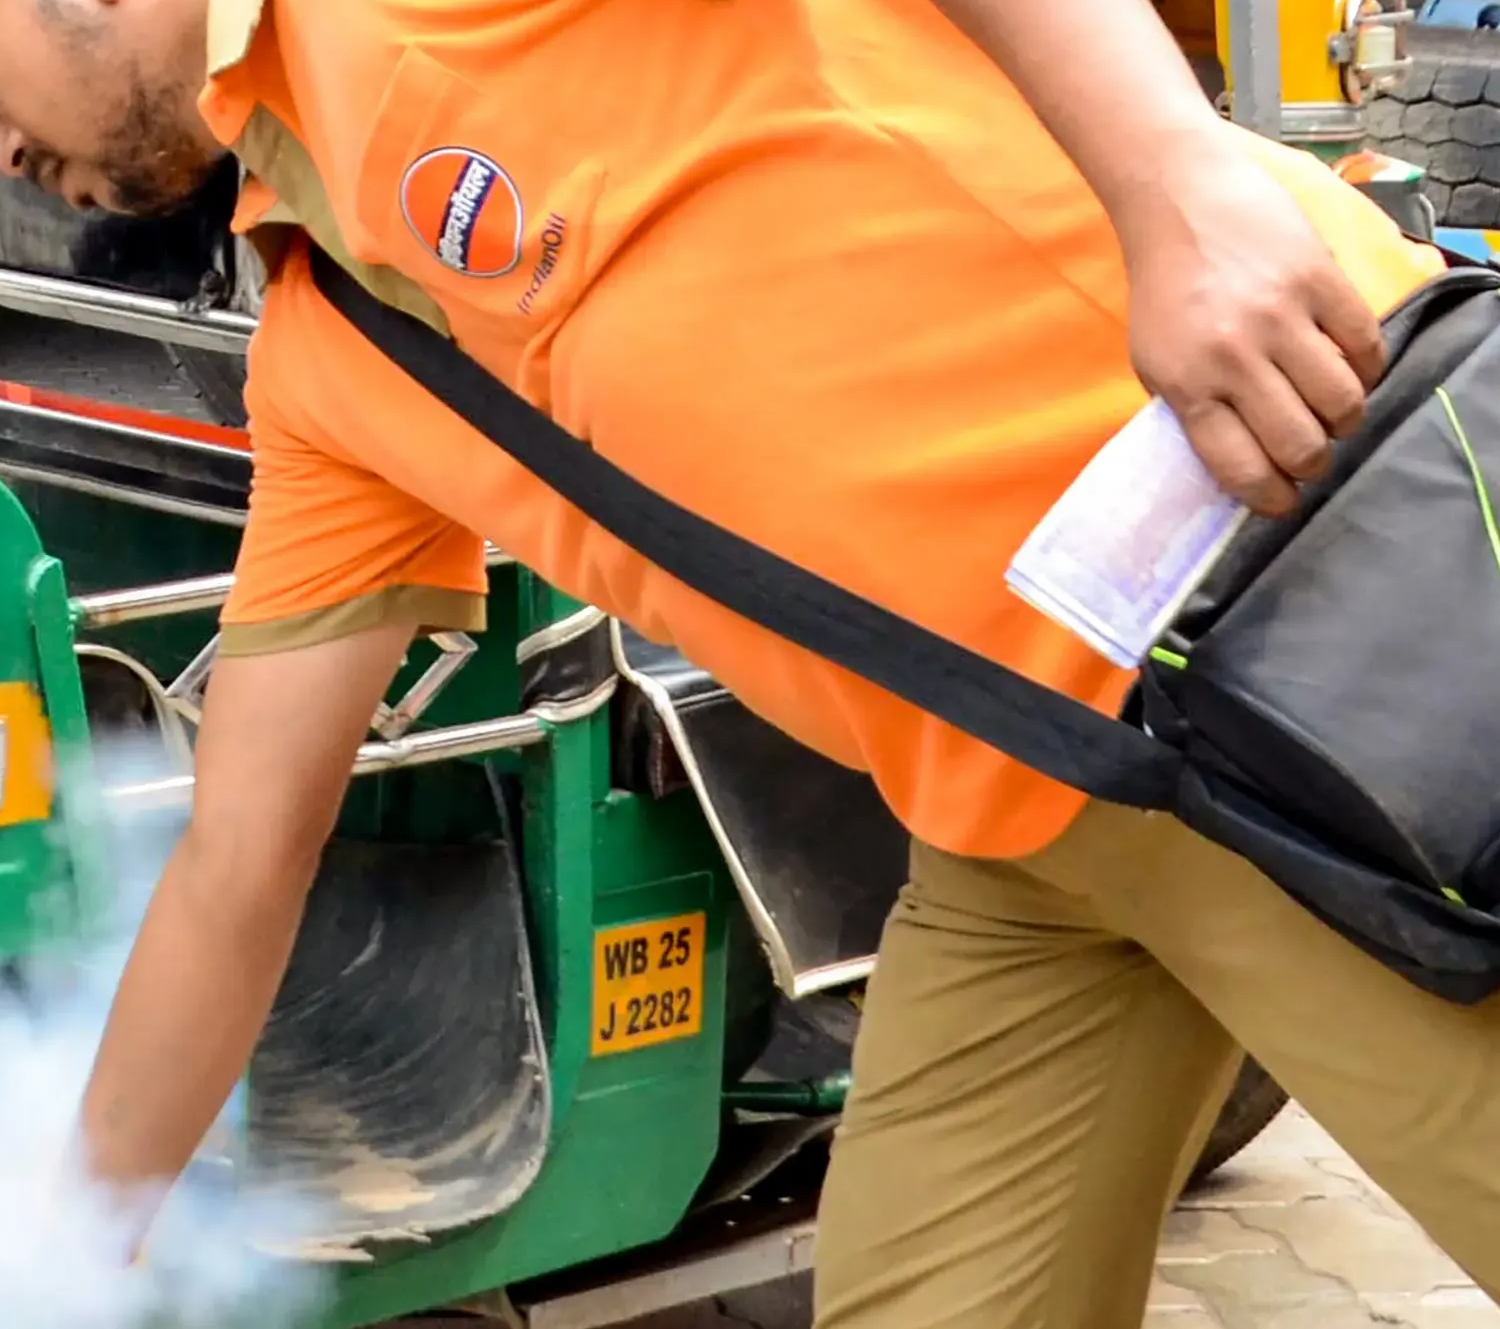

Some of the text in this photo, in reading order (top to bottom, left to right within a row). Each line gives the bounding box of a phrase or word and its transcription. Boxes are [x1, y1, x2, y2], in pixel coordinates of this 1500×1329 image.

[516, 212, 567, 316] IndianOil
[605, 927, 691, 980] WB 25
[601, 987, 691, 1040] J 2282
